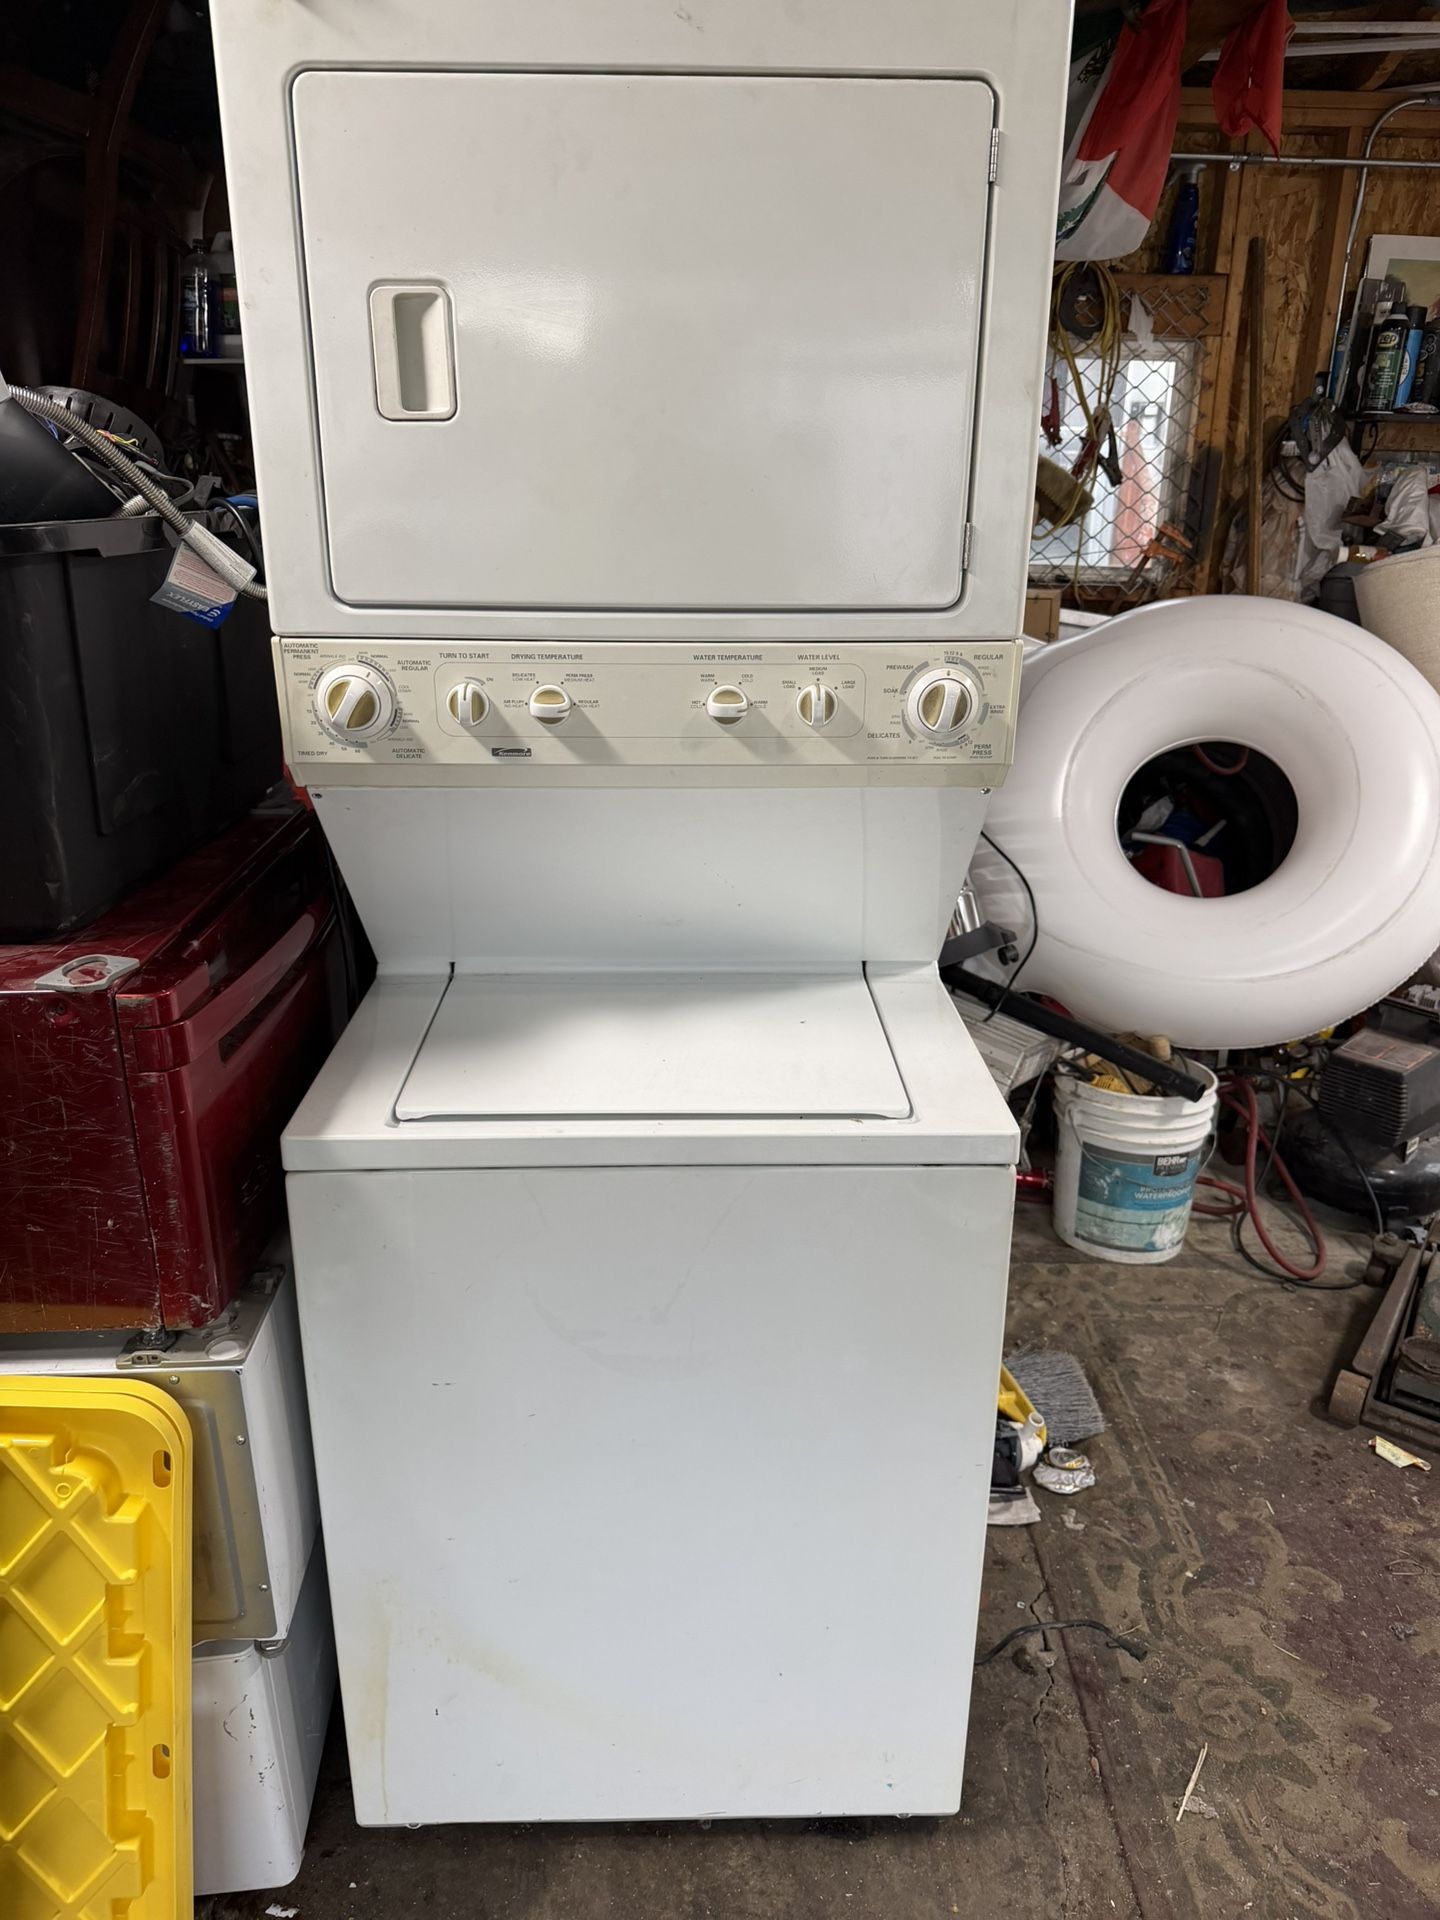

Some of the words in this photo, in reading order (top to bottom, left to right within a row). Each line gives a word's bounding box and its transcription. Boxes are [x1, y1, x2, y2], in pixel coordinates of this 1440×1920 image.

[1380, 333, 1397, 344] zep
[166, 592, 210, 612] EASYFLEX
[1157, 1156, 1180, 1166] BEHR
